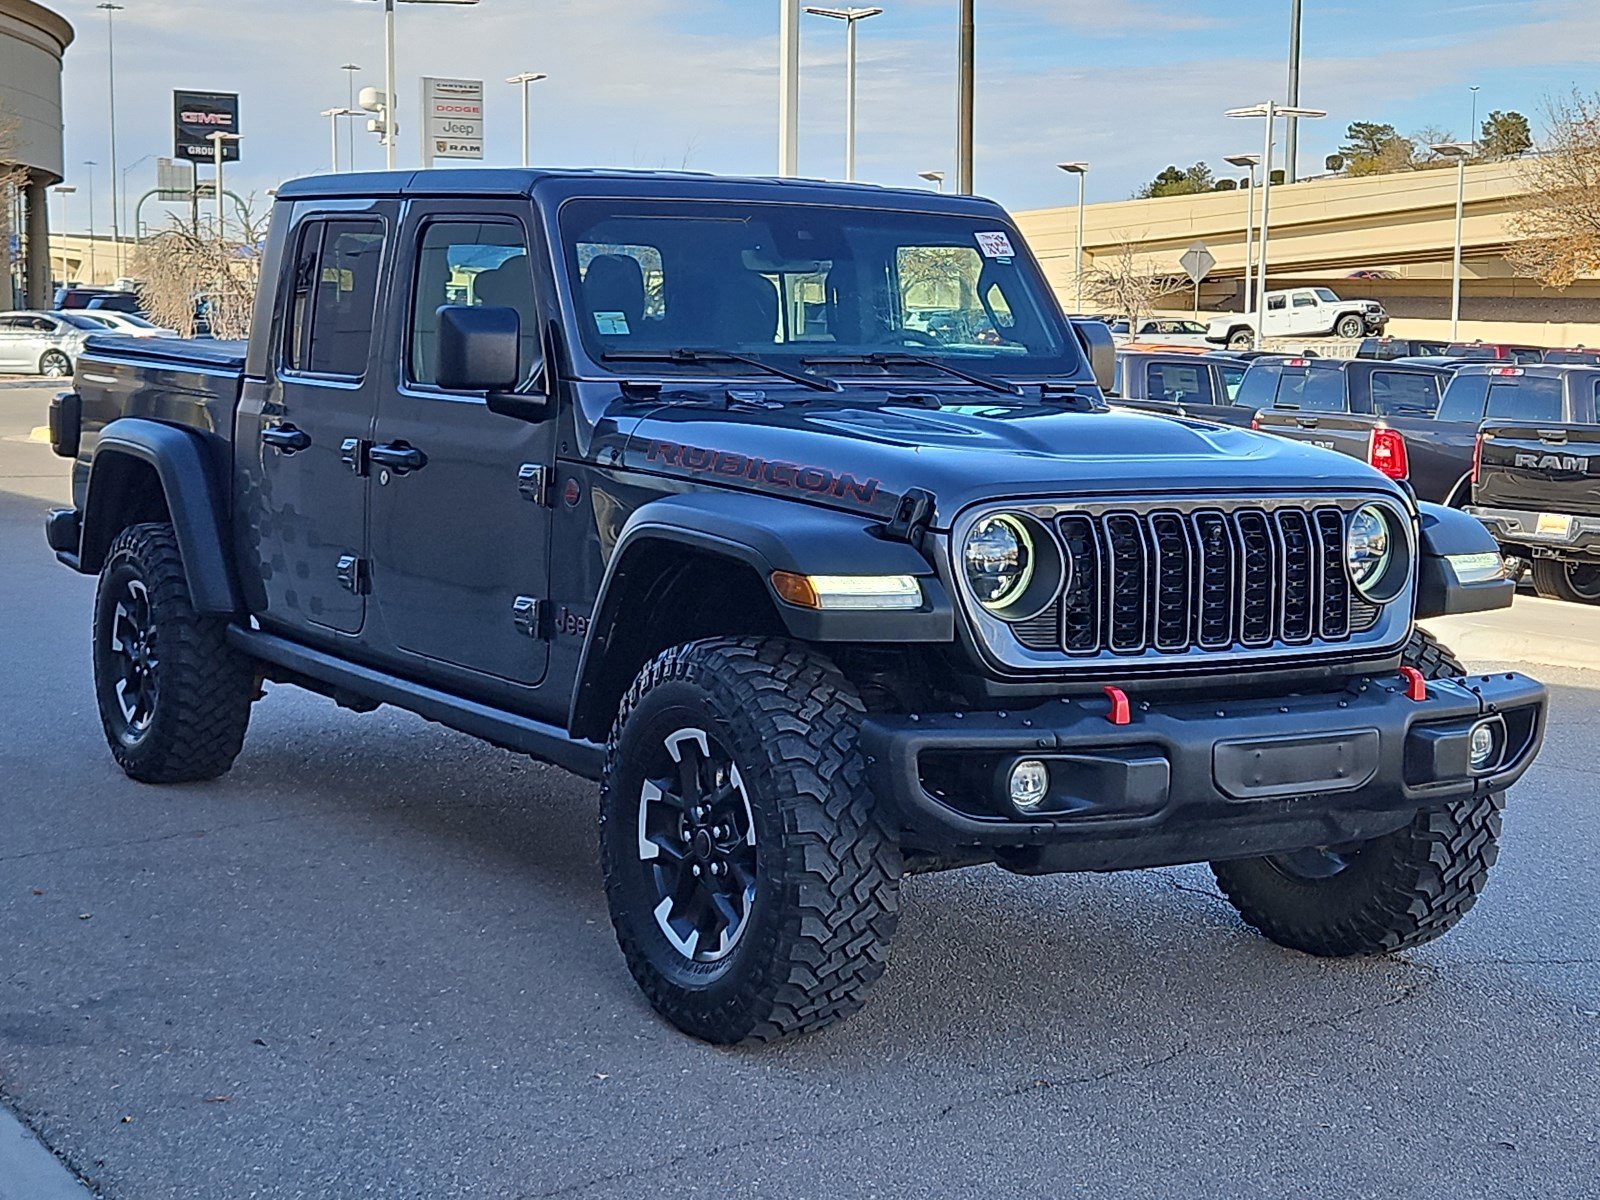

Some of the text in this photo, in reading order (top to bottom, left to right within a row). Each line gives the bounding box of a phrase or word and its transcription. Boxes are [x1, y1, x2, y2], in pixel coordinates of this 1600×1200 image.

[436, 105, 480, 113] DODGE
[180, 111, 232, 124] GMC
[442, 121, 475, 136] Jeep
[187, 145, 219, 156] GROU
[449, 144, 481, 152] RAM
[1514, 453, 1589, 472] RAM
[646, 439, 880, 504] RUBICON
[555, 606, 592, 636] Jee
